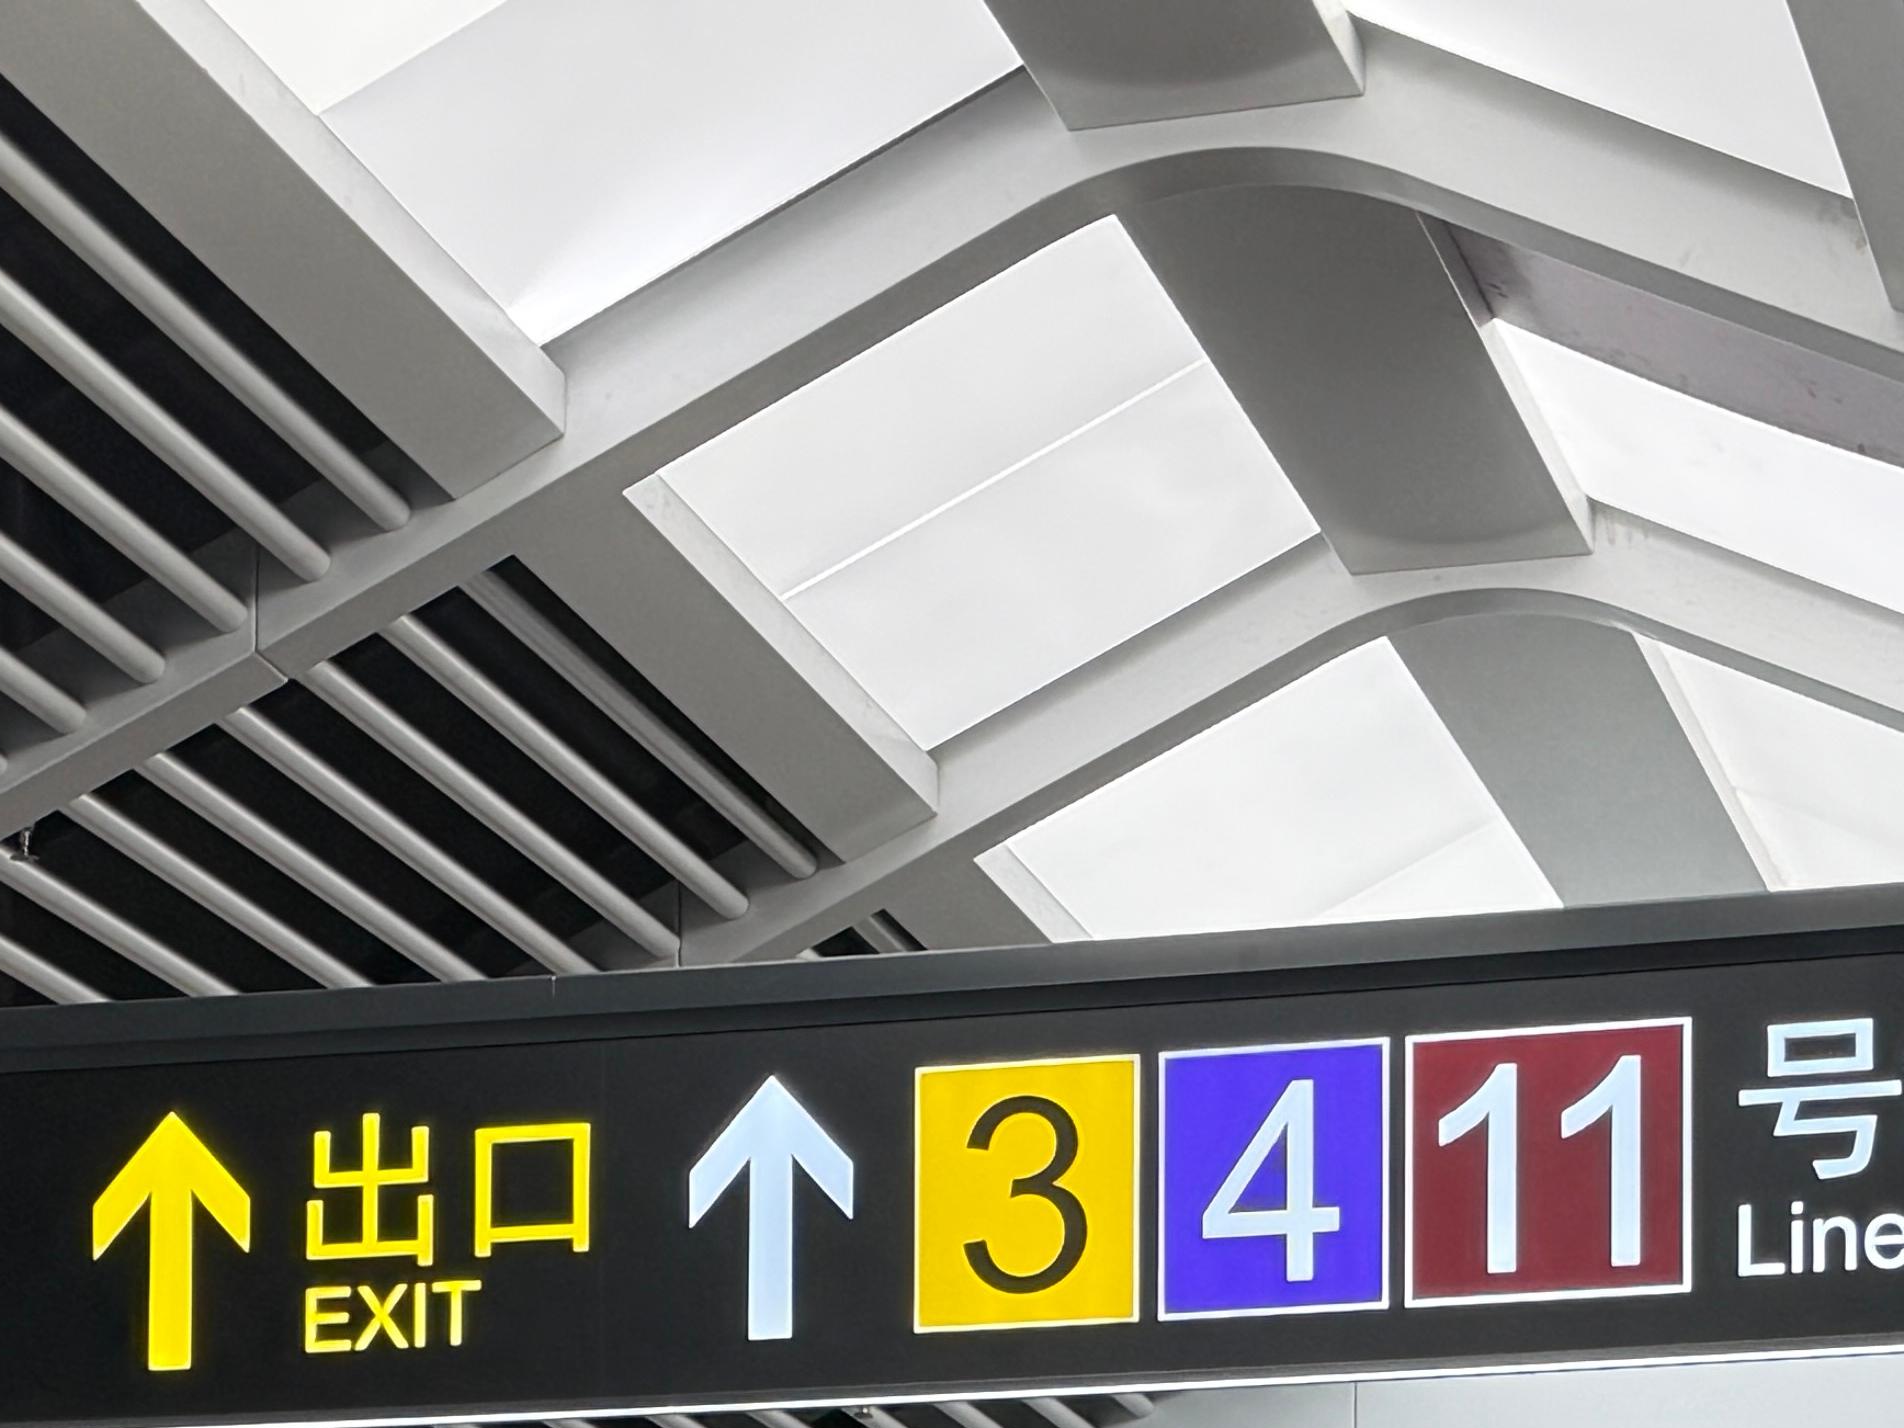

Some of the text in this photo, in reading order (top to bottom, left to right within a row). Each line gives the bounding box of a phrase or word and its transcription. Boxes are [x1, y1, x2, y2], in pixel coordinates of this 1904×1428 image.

[305, 1112, 591, 1267] 出口
[961, 1094, 1089, 1294] 3
[1200, 1077, 1340, 1282] 4
[1435, 1054, 1644, 1274] 11
[305, 1279, 483, 1354] EXIT
